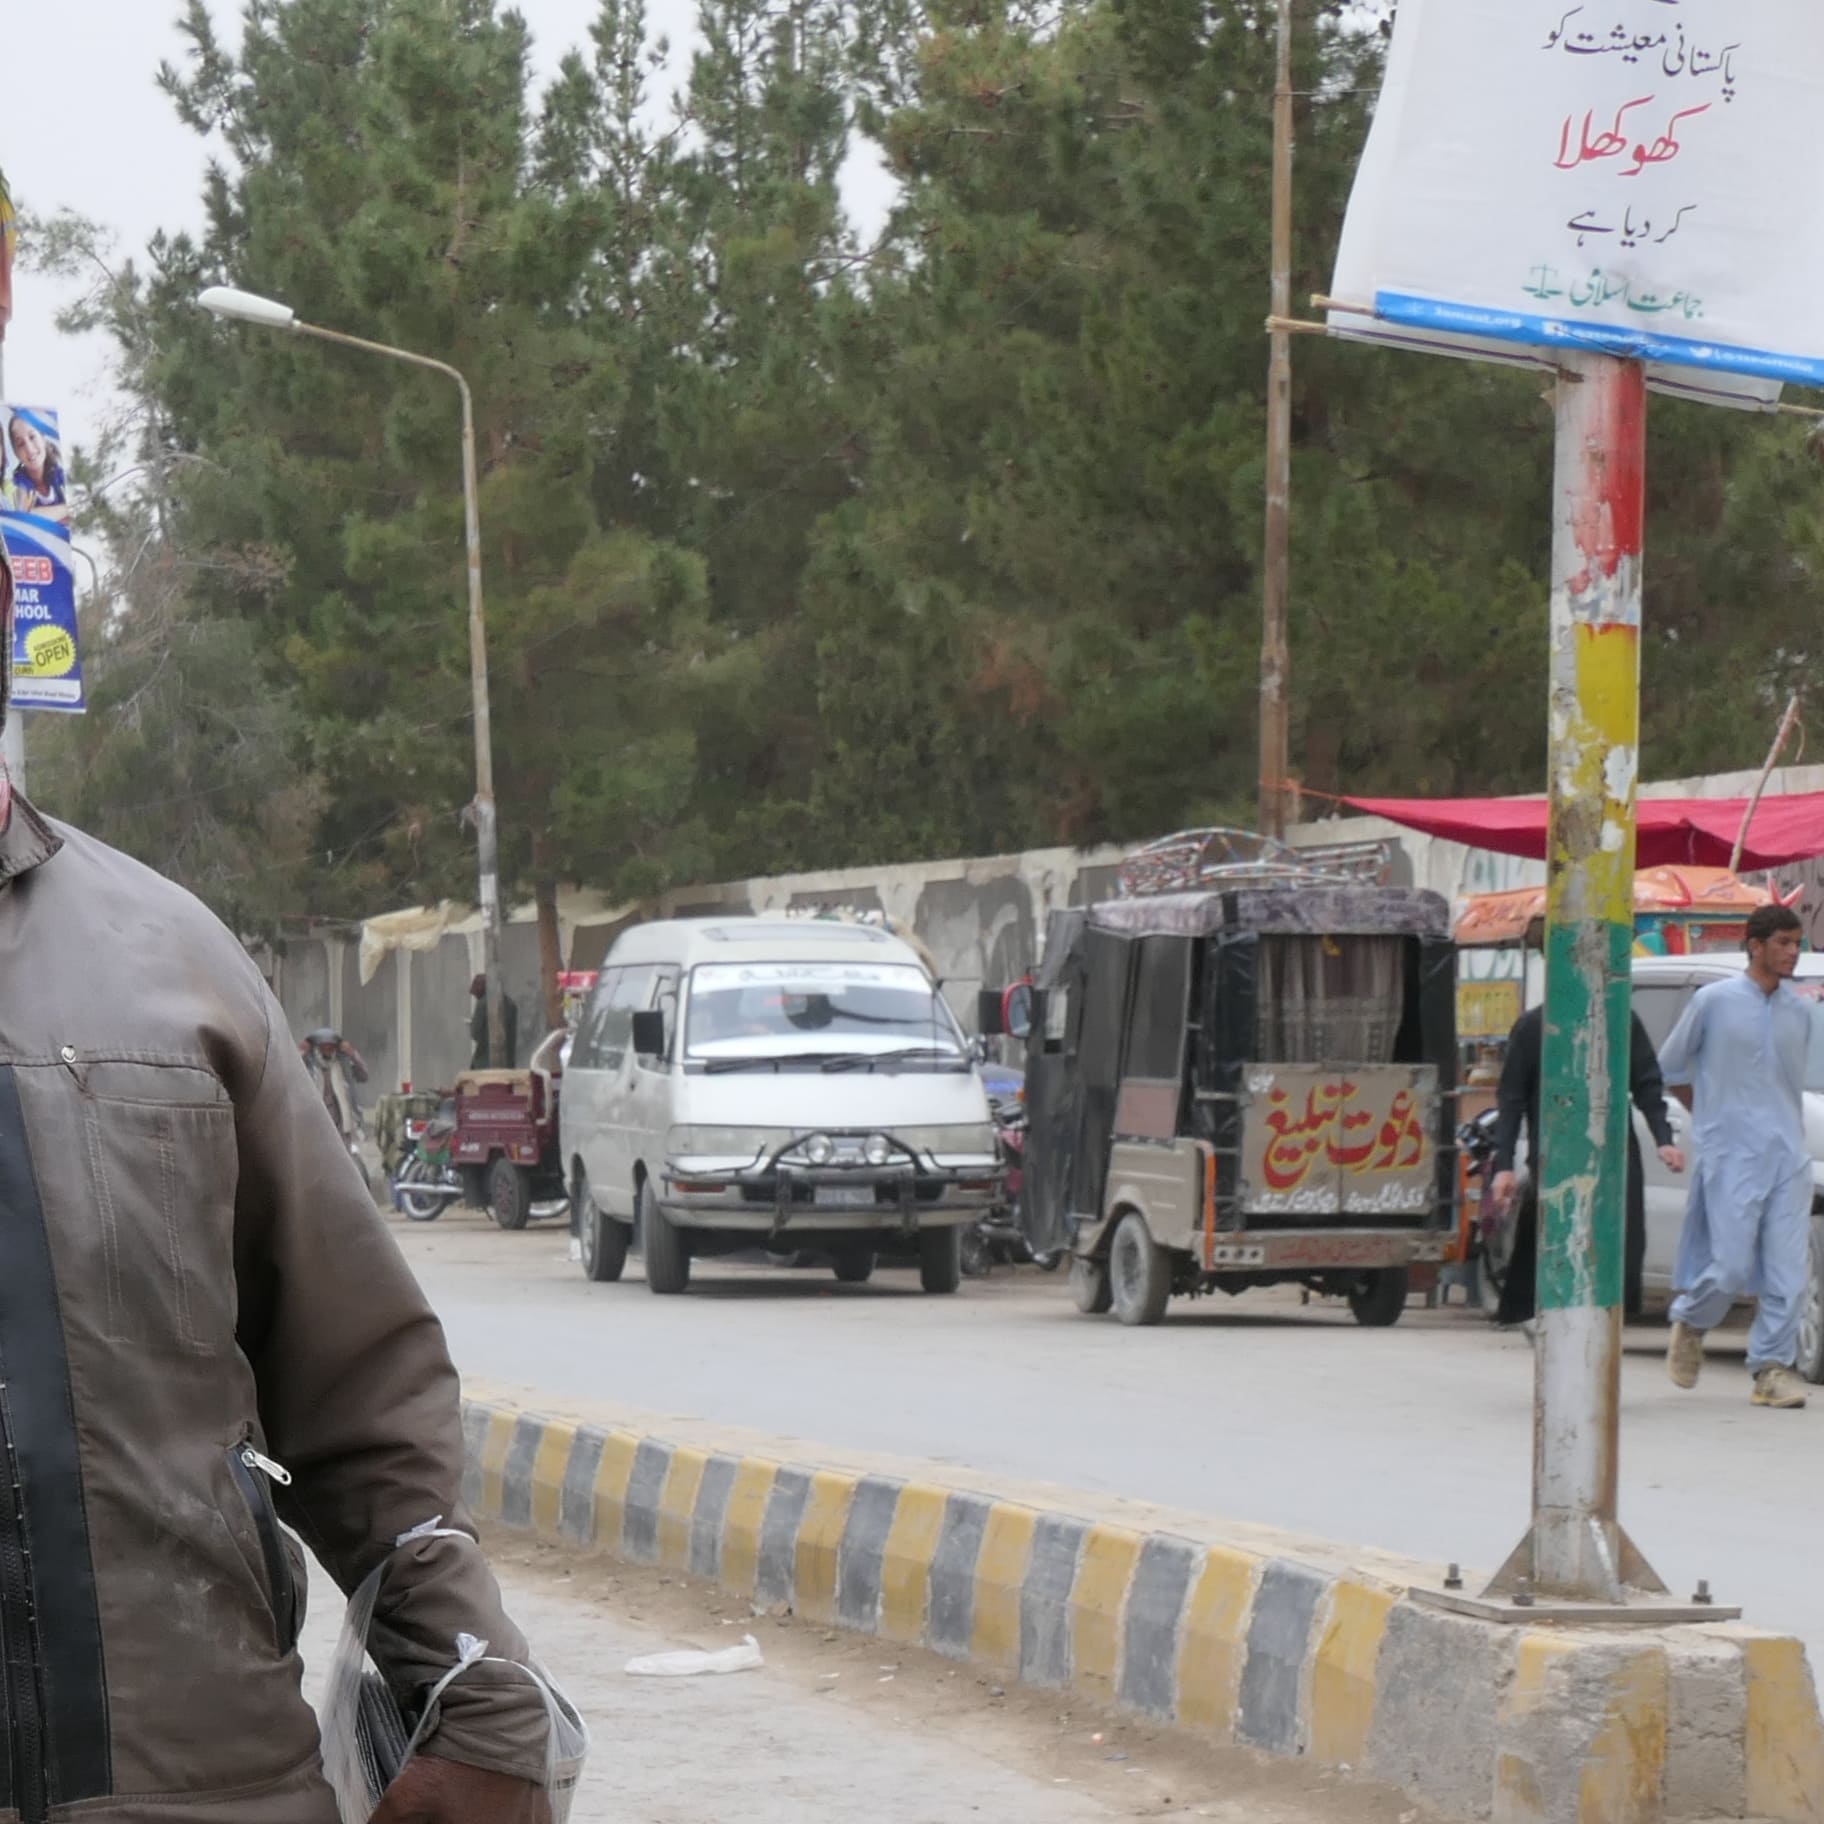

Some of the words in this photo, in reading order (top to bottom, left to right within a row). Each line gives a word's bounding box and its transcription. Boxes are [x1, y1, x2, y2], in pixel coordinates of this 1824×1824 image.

[1541, 6, 1584, 49] کو
[1564, 24, 1666, 63] معیشت
[1662, 23, 1740, 103] پاکستانی
[1567, 210, 1615, 248] ہے
[1626, 288, 1704, 319] جماعت
[14, 604, 52, 621] HOOL
[35, 642, 70, 668] OPEN
